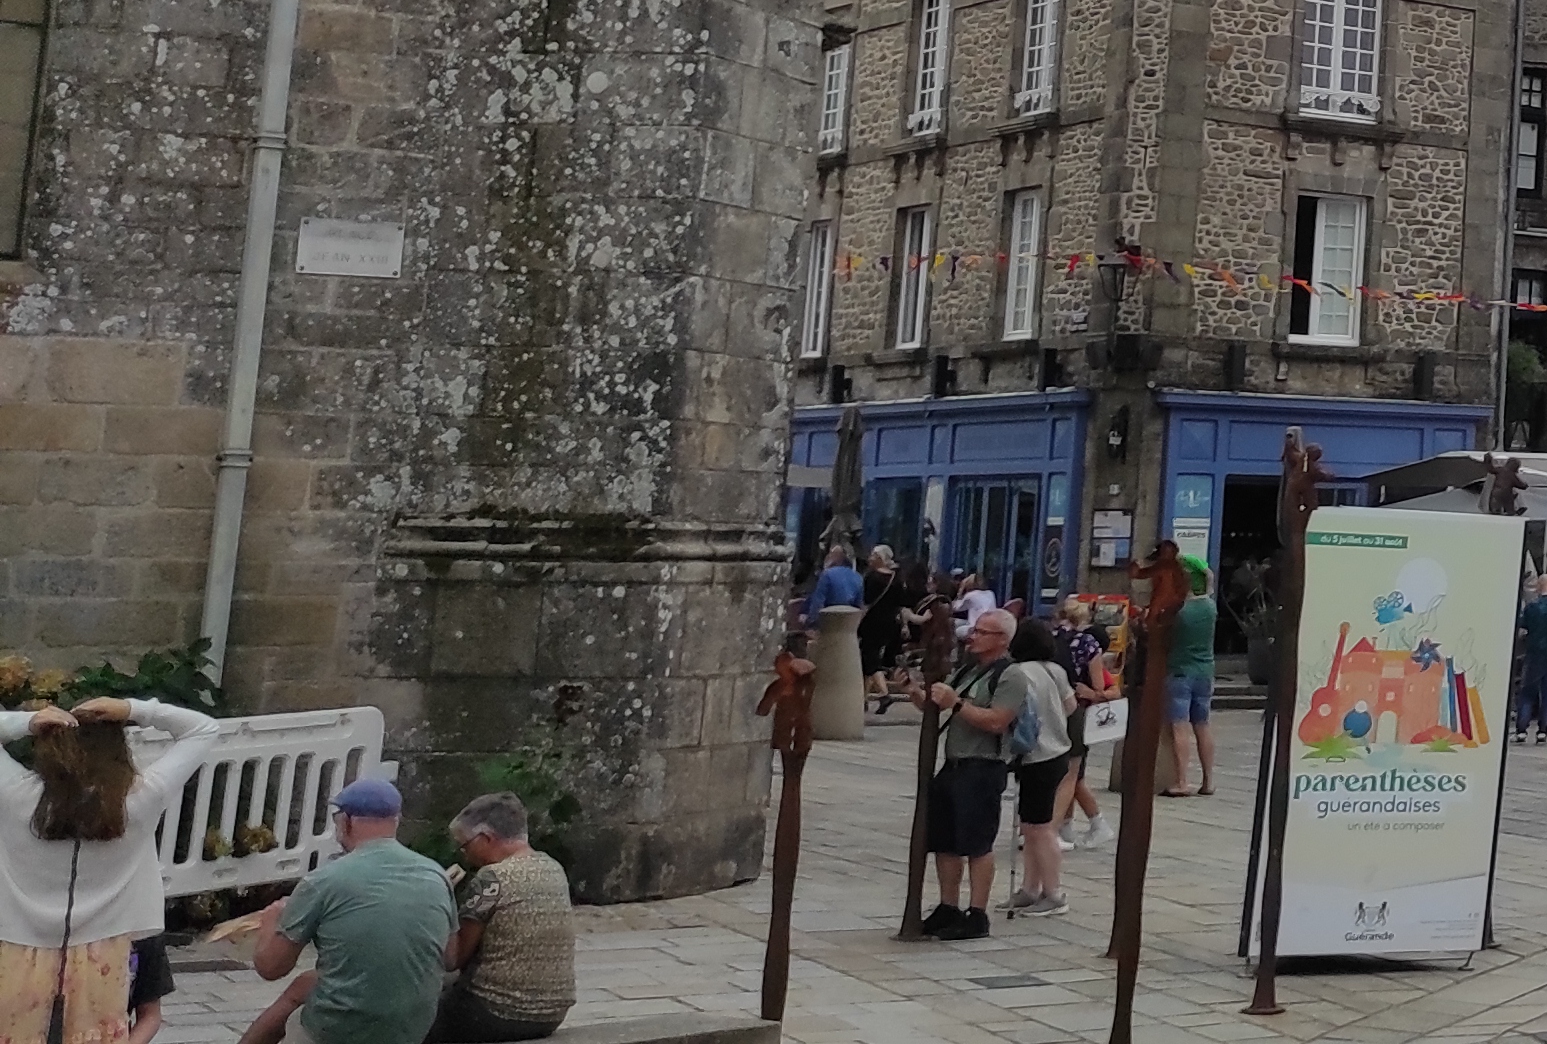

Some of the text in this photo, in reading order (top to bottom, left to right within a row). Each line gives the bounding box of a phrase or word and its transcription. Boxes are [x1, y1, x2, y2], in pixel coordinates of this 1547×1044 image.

[1320, 535, 1332, 543] du
[1333, 535, 1339, 543] 5
[1338, 535, 1362, 545] juillet
[1375, 536, 1384, 545] 31
[1293, 768, 1467, 799] parenthèses
[1317, 795, 1441, 818] guérandaises
[1392, 823, 1445, 833] composer
[1344, 931, 1395, 942] Guérande
